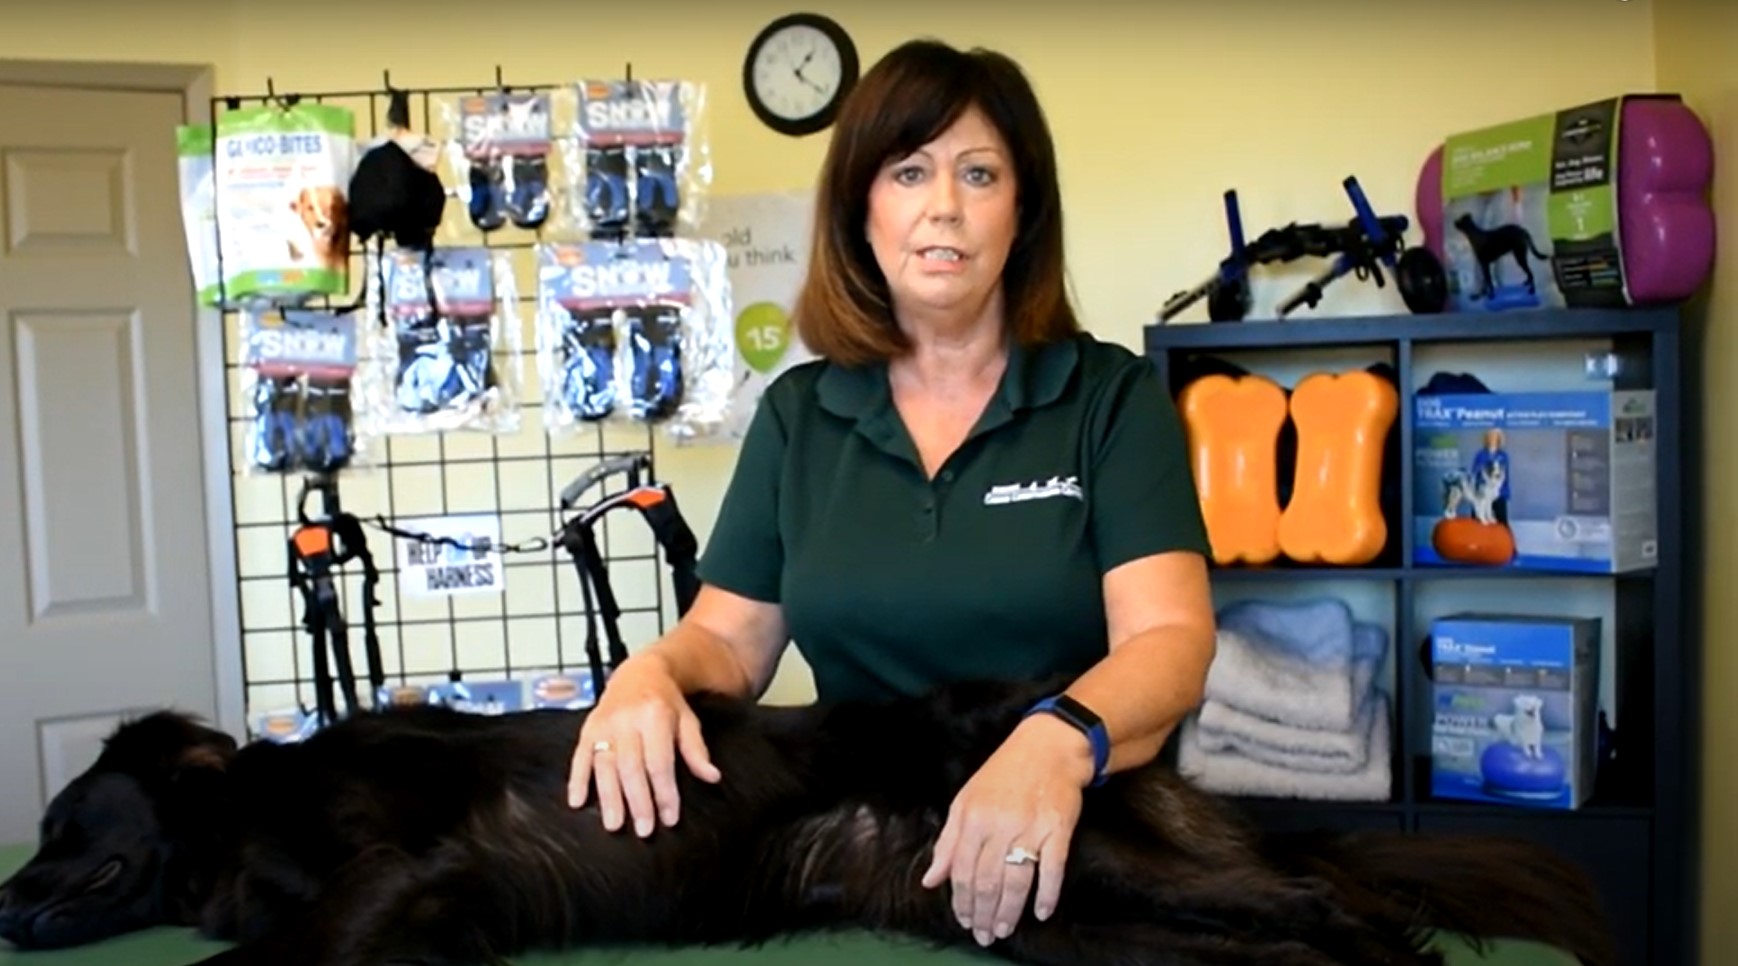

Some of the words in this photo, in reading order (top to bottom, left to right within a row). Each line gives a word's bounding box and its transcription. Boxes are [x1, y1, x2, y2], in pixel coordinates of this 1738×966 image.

[586, 99, 670, 130] SNOW
[745, 245, 798, 267] think
[570, 260, 670, 297] SNOW
[259, 328, 346, 361] SNOW
[1457, 407, 1504, 420] Peanut
[426, 563, 494, 590] HARNESS
